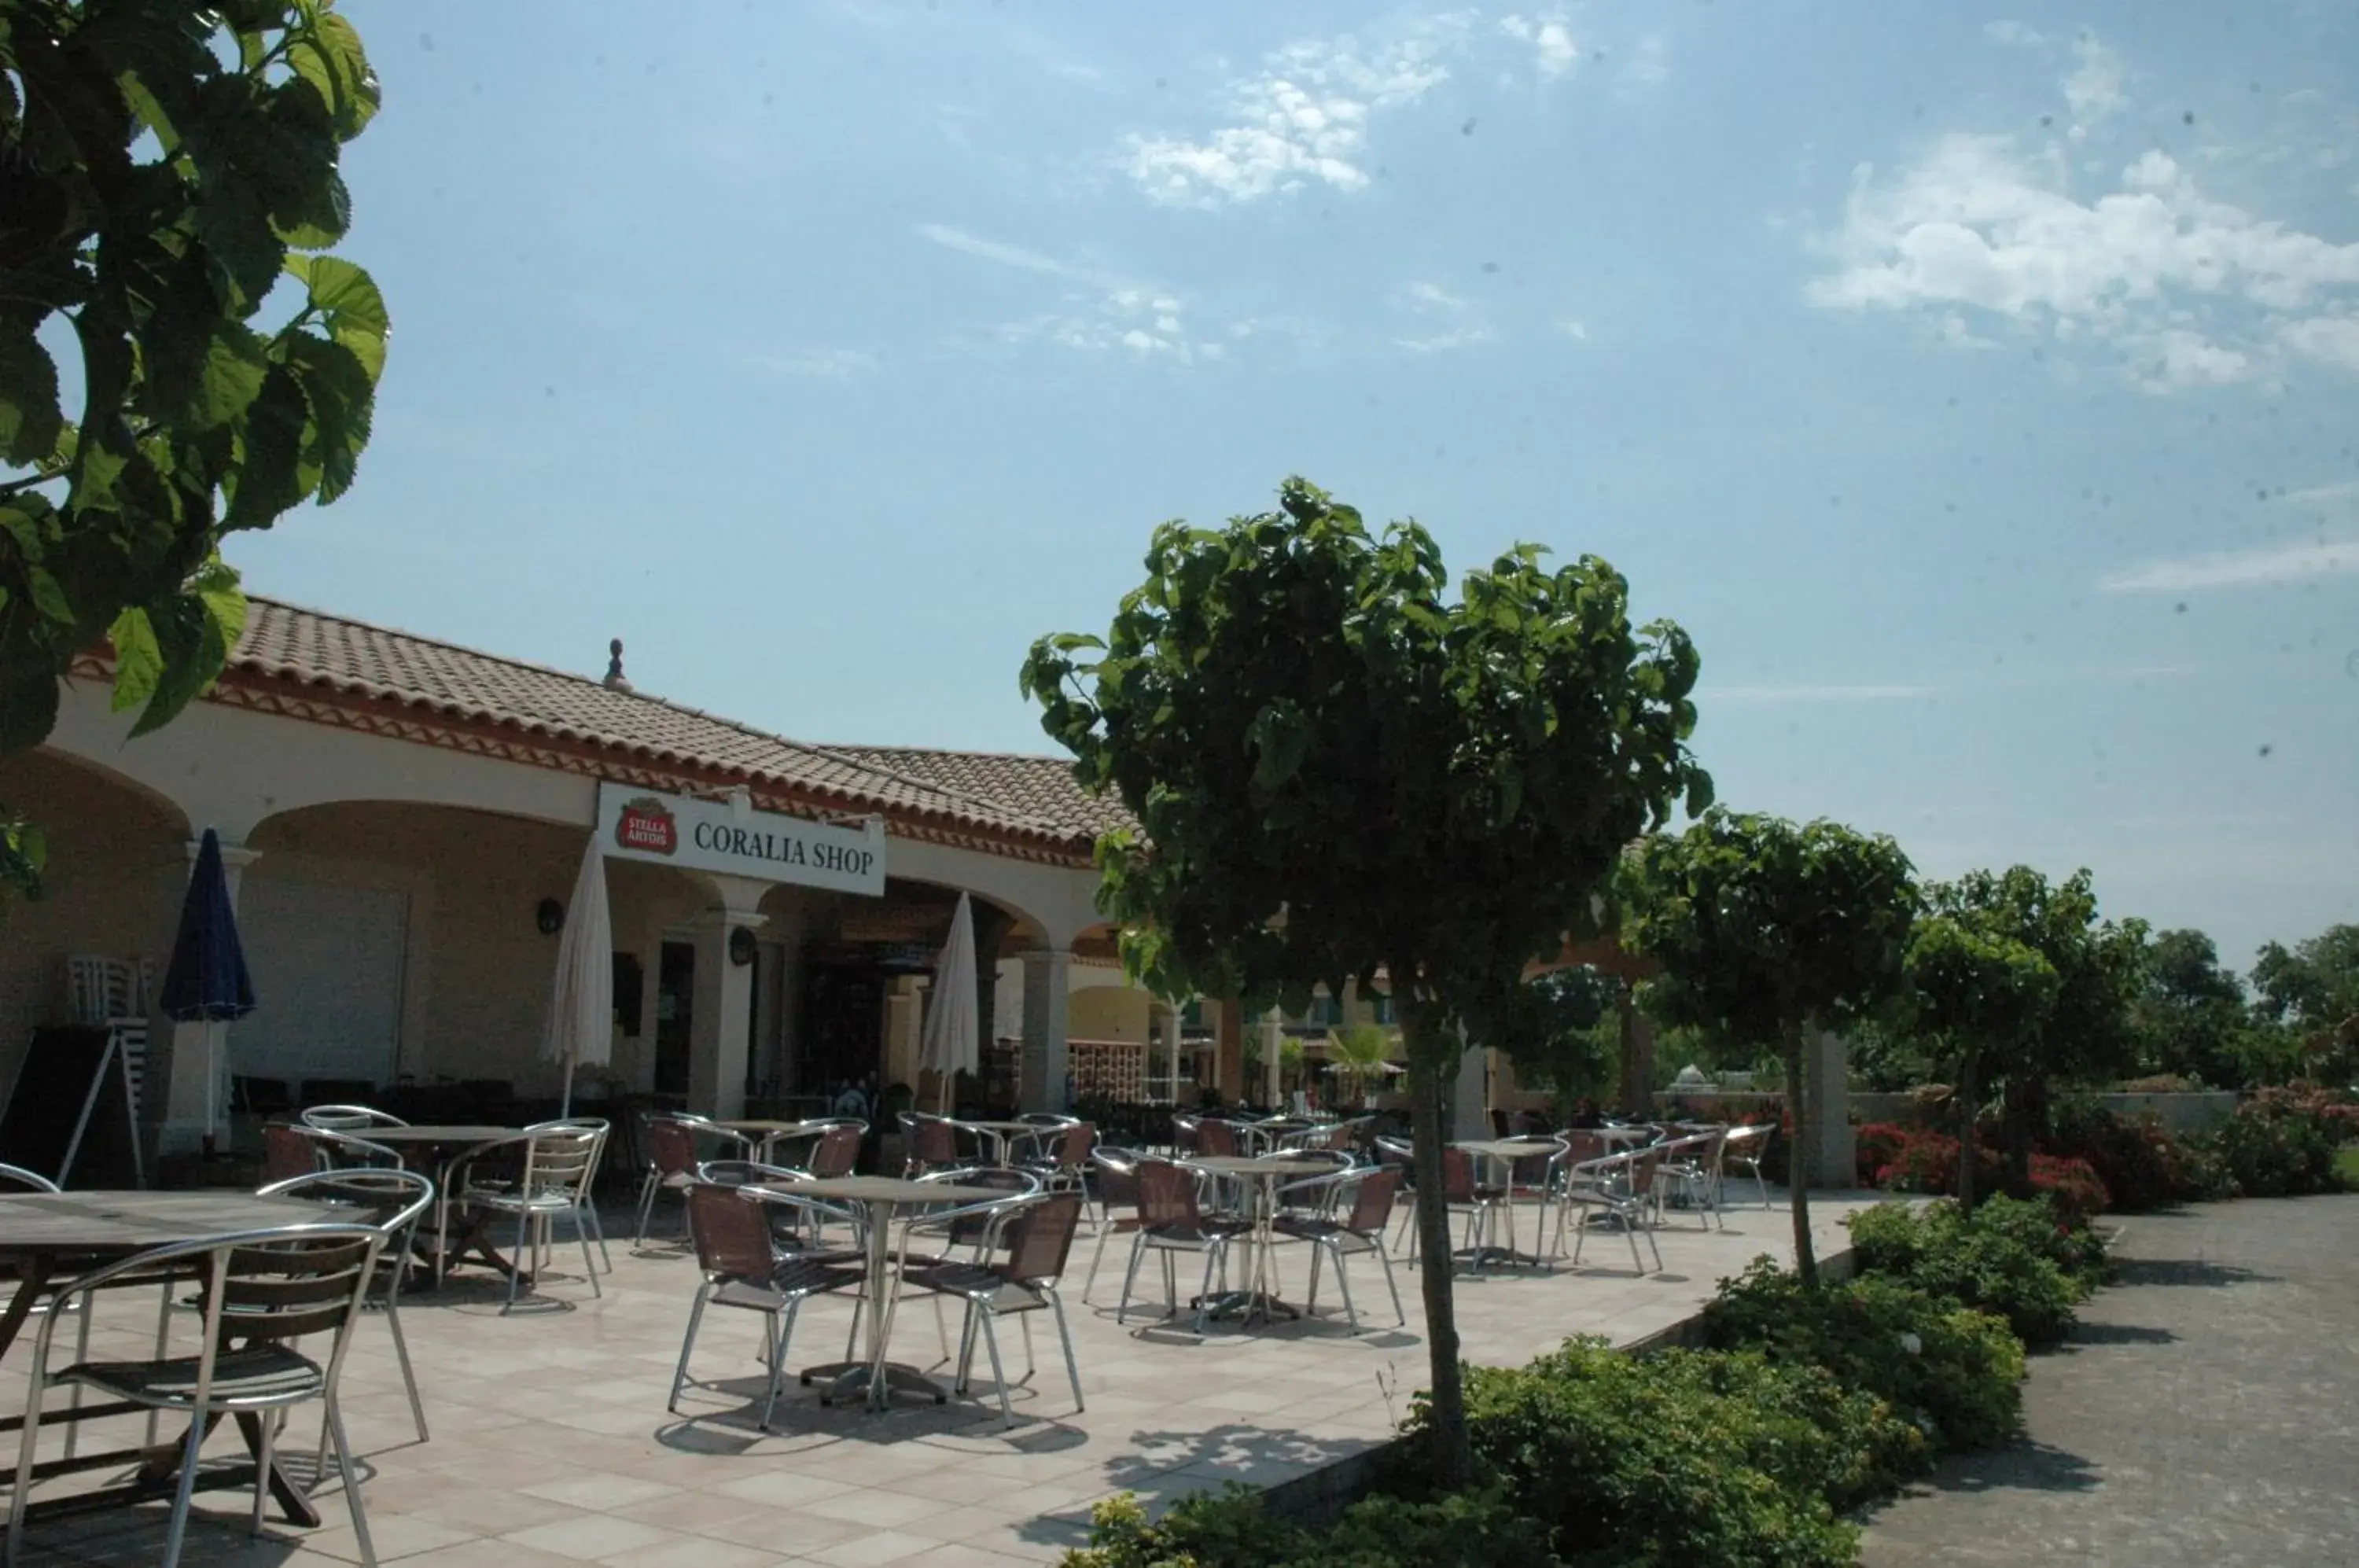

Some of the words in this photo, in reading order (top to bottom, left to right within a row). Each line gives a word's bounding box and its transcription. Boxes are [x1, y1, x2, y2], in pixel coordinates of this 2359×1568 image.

[628, 817, 667, 834] STELLA
[627, 830, 667, 846] ARTOIS
[694, 821, 806, 865] CORALIA
[812, 842, 874, 875] SHOP
